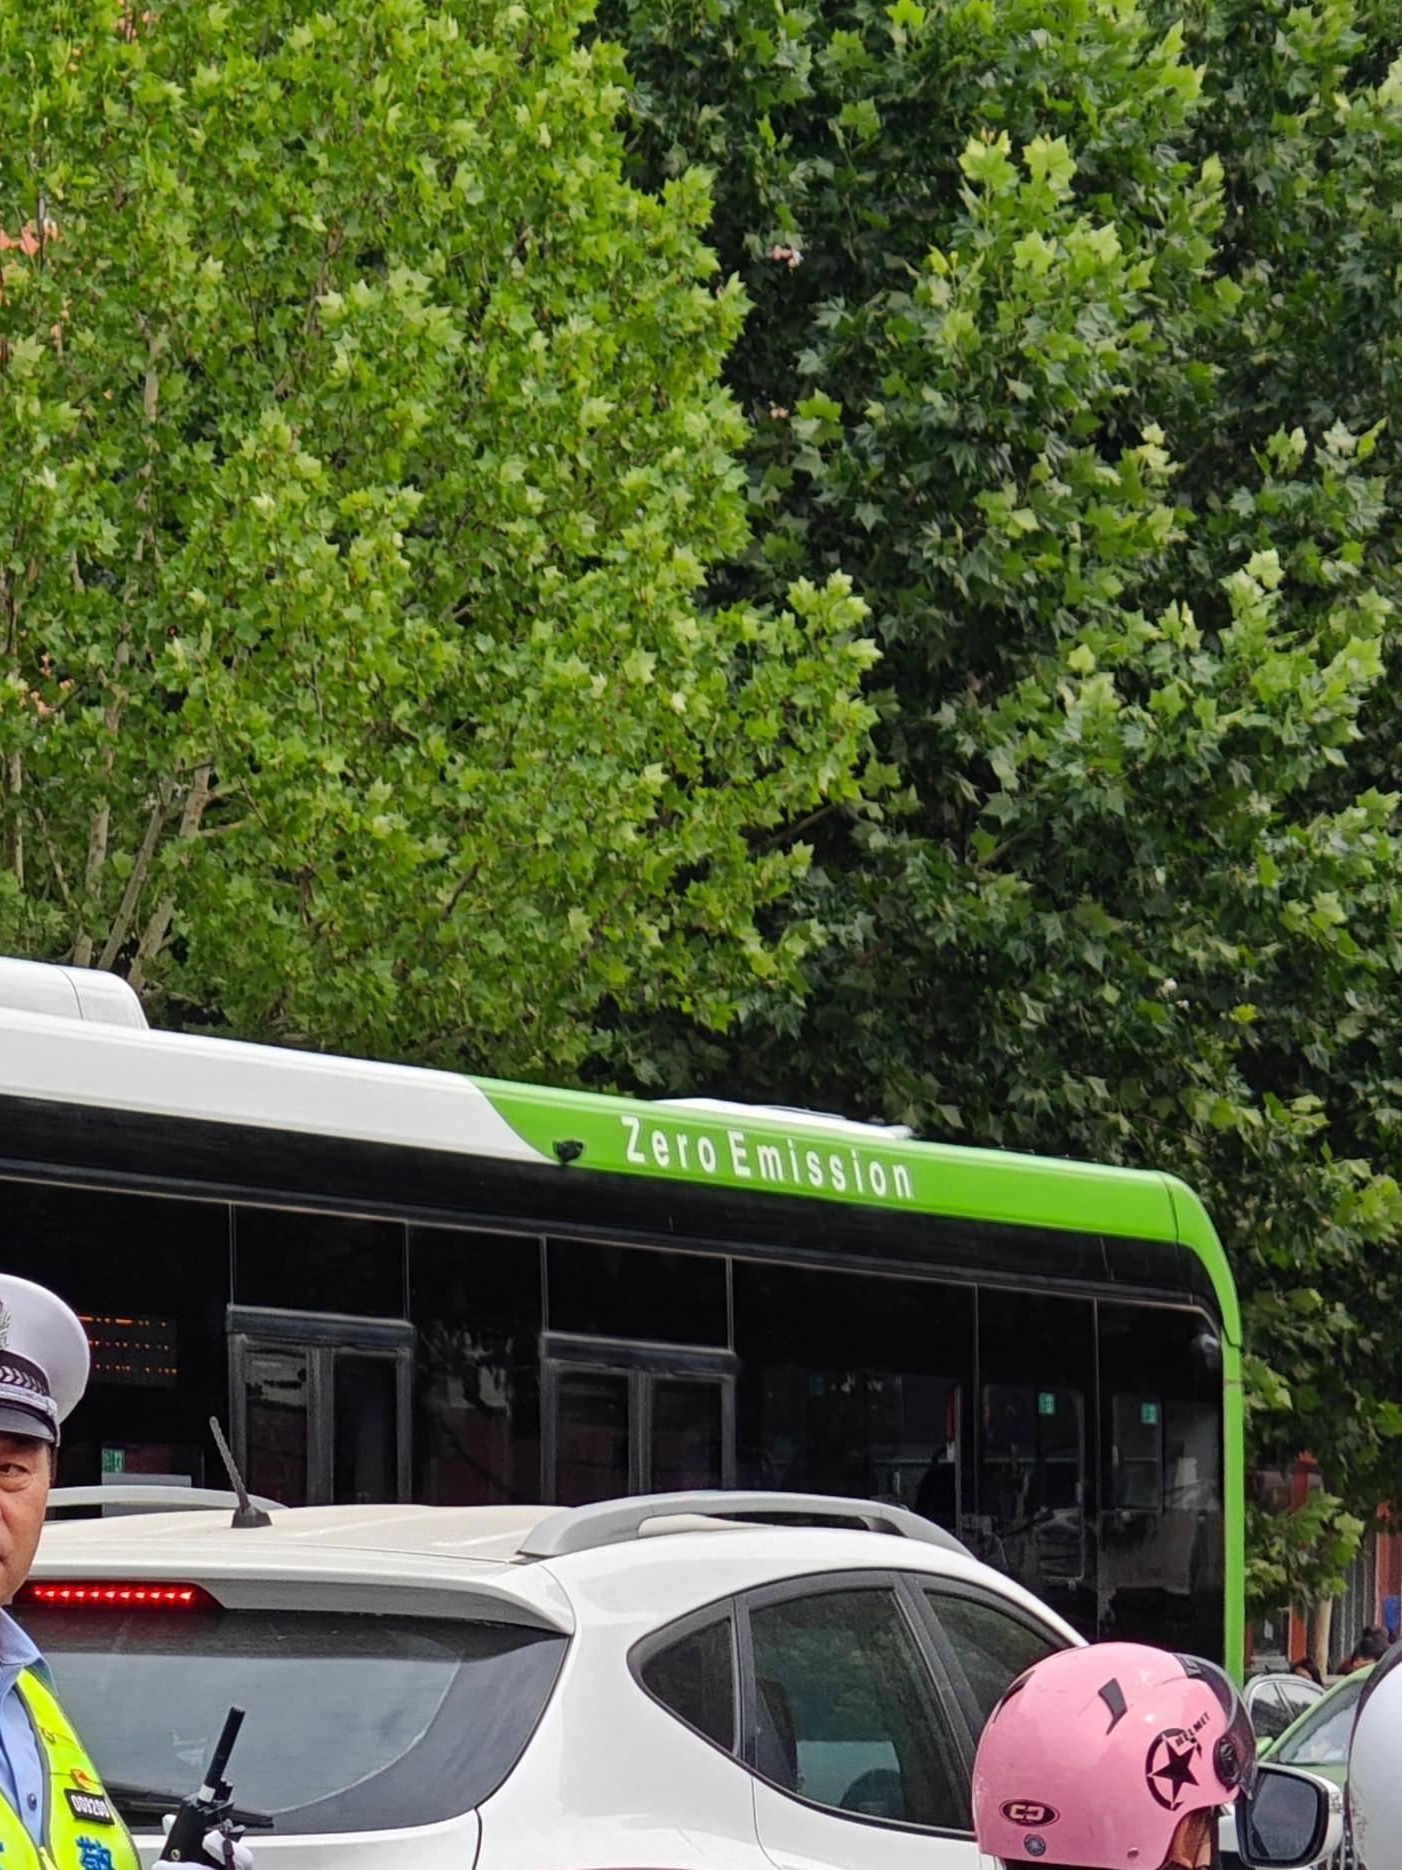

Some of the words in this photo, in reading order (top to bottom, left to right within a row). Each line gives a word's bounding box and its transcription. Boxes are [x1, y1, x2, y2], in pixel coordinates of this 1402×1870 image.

[620, 1115, 717, 1174] Zero
[728, 1130, 915, 1199] Emission
[1175, 1711, 1210, 1747] HELMET
